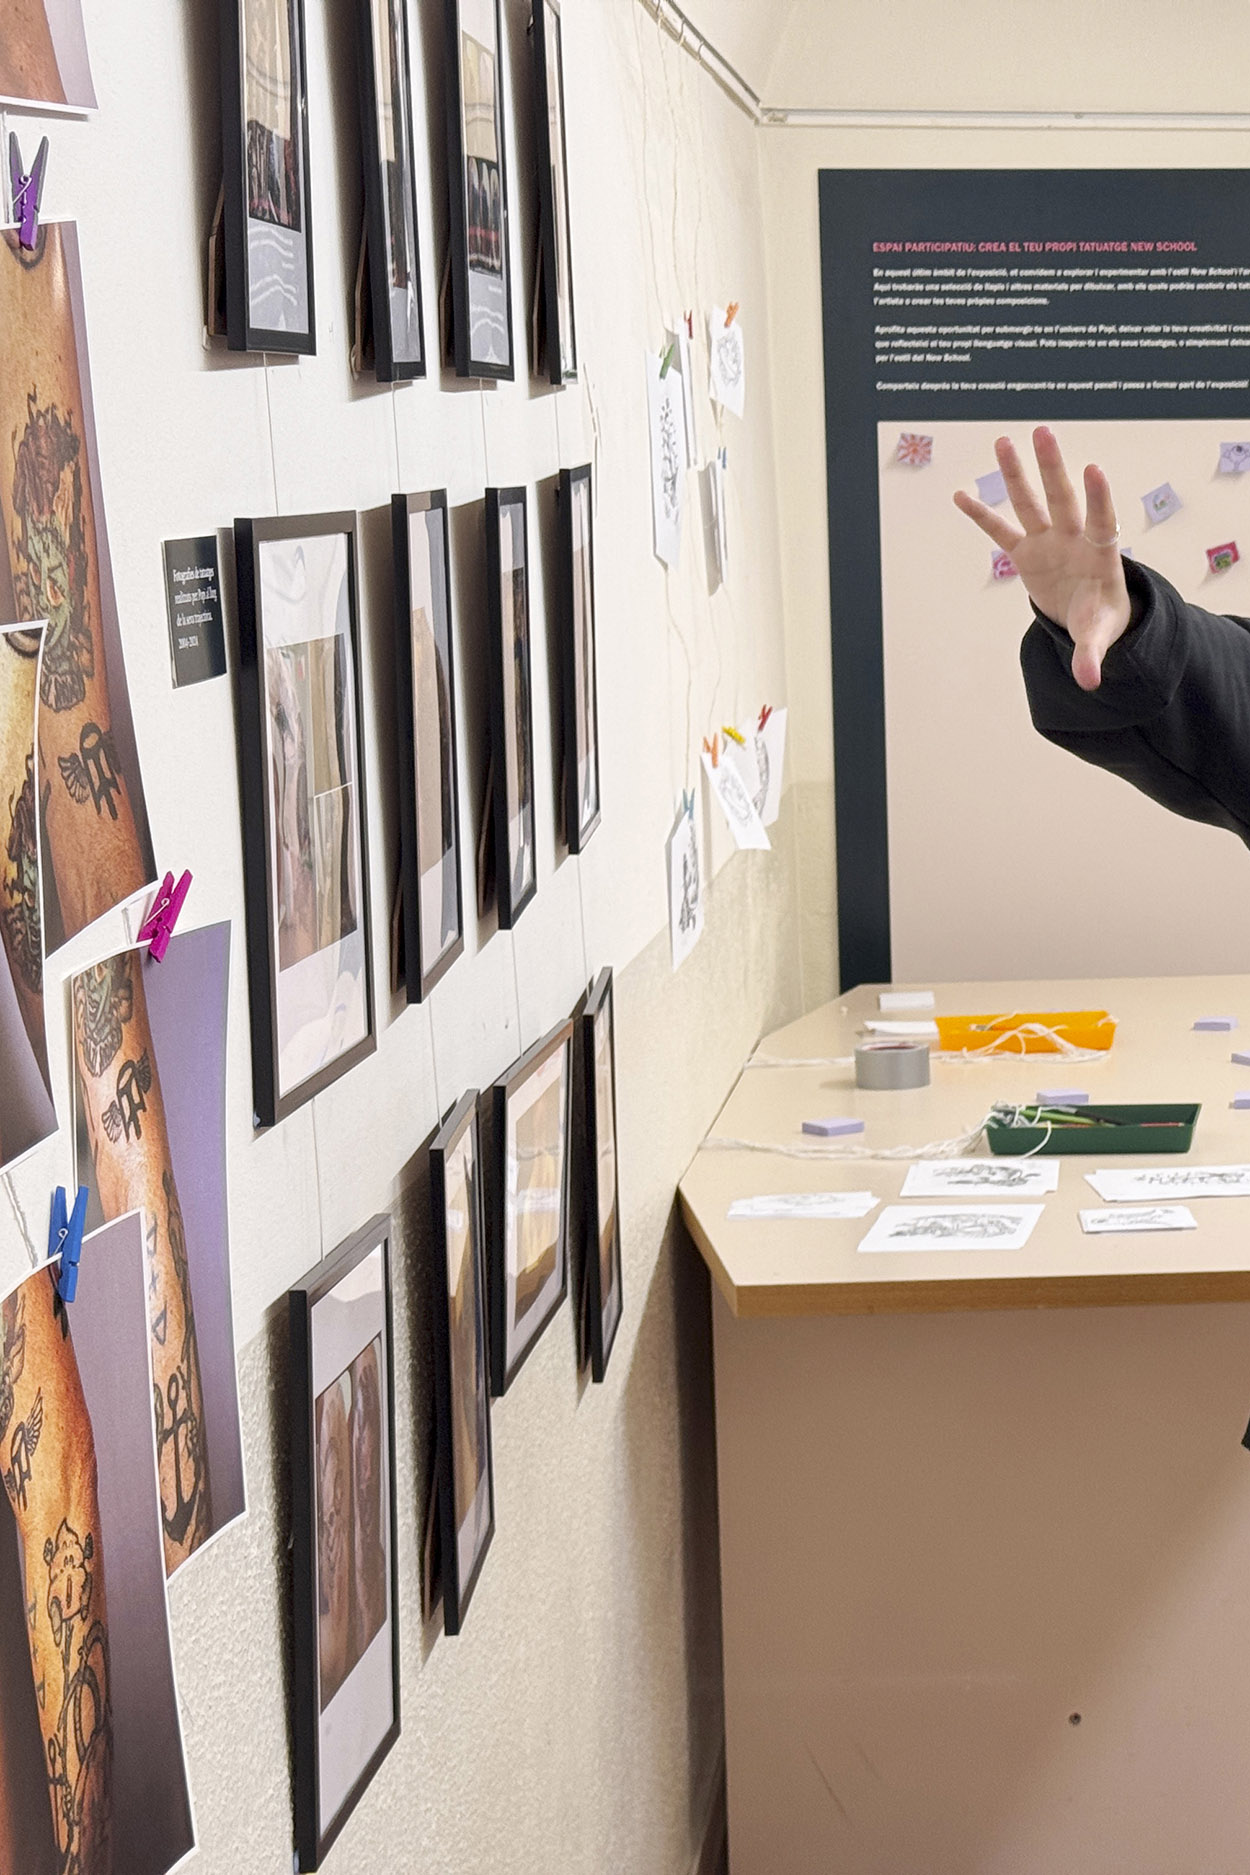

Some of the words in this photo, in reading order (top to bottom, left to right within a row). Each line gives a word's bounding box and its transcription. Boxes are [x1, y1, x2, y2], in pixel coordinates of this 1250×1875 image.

[873, 242, 902, 252] ESPAI
[905, 242, 975, 252] PARTICIPATIU:
[978, 242, 1006, 252] CREA
[1009, 242, 1019, 252] EL
[1024, 242, 1043, 252] TEU
[1045, 242, 1077, 252] PROPI
[1080, 242, 1127, 252] TATUATGE
[1130, 242, 1153, 252] NEW
[1156, 242, 1196, 252] SCHOOL
